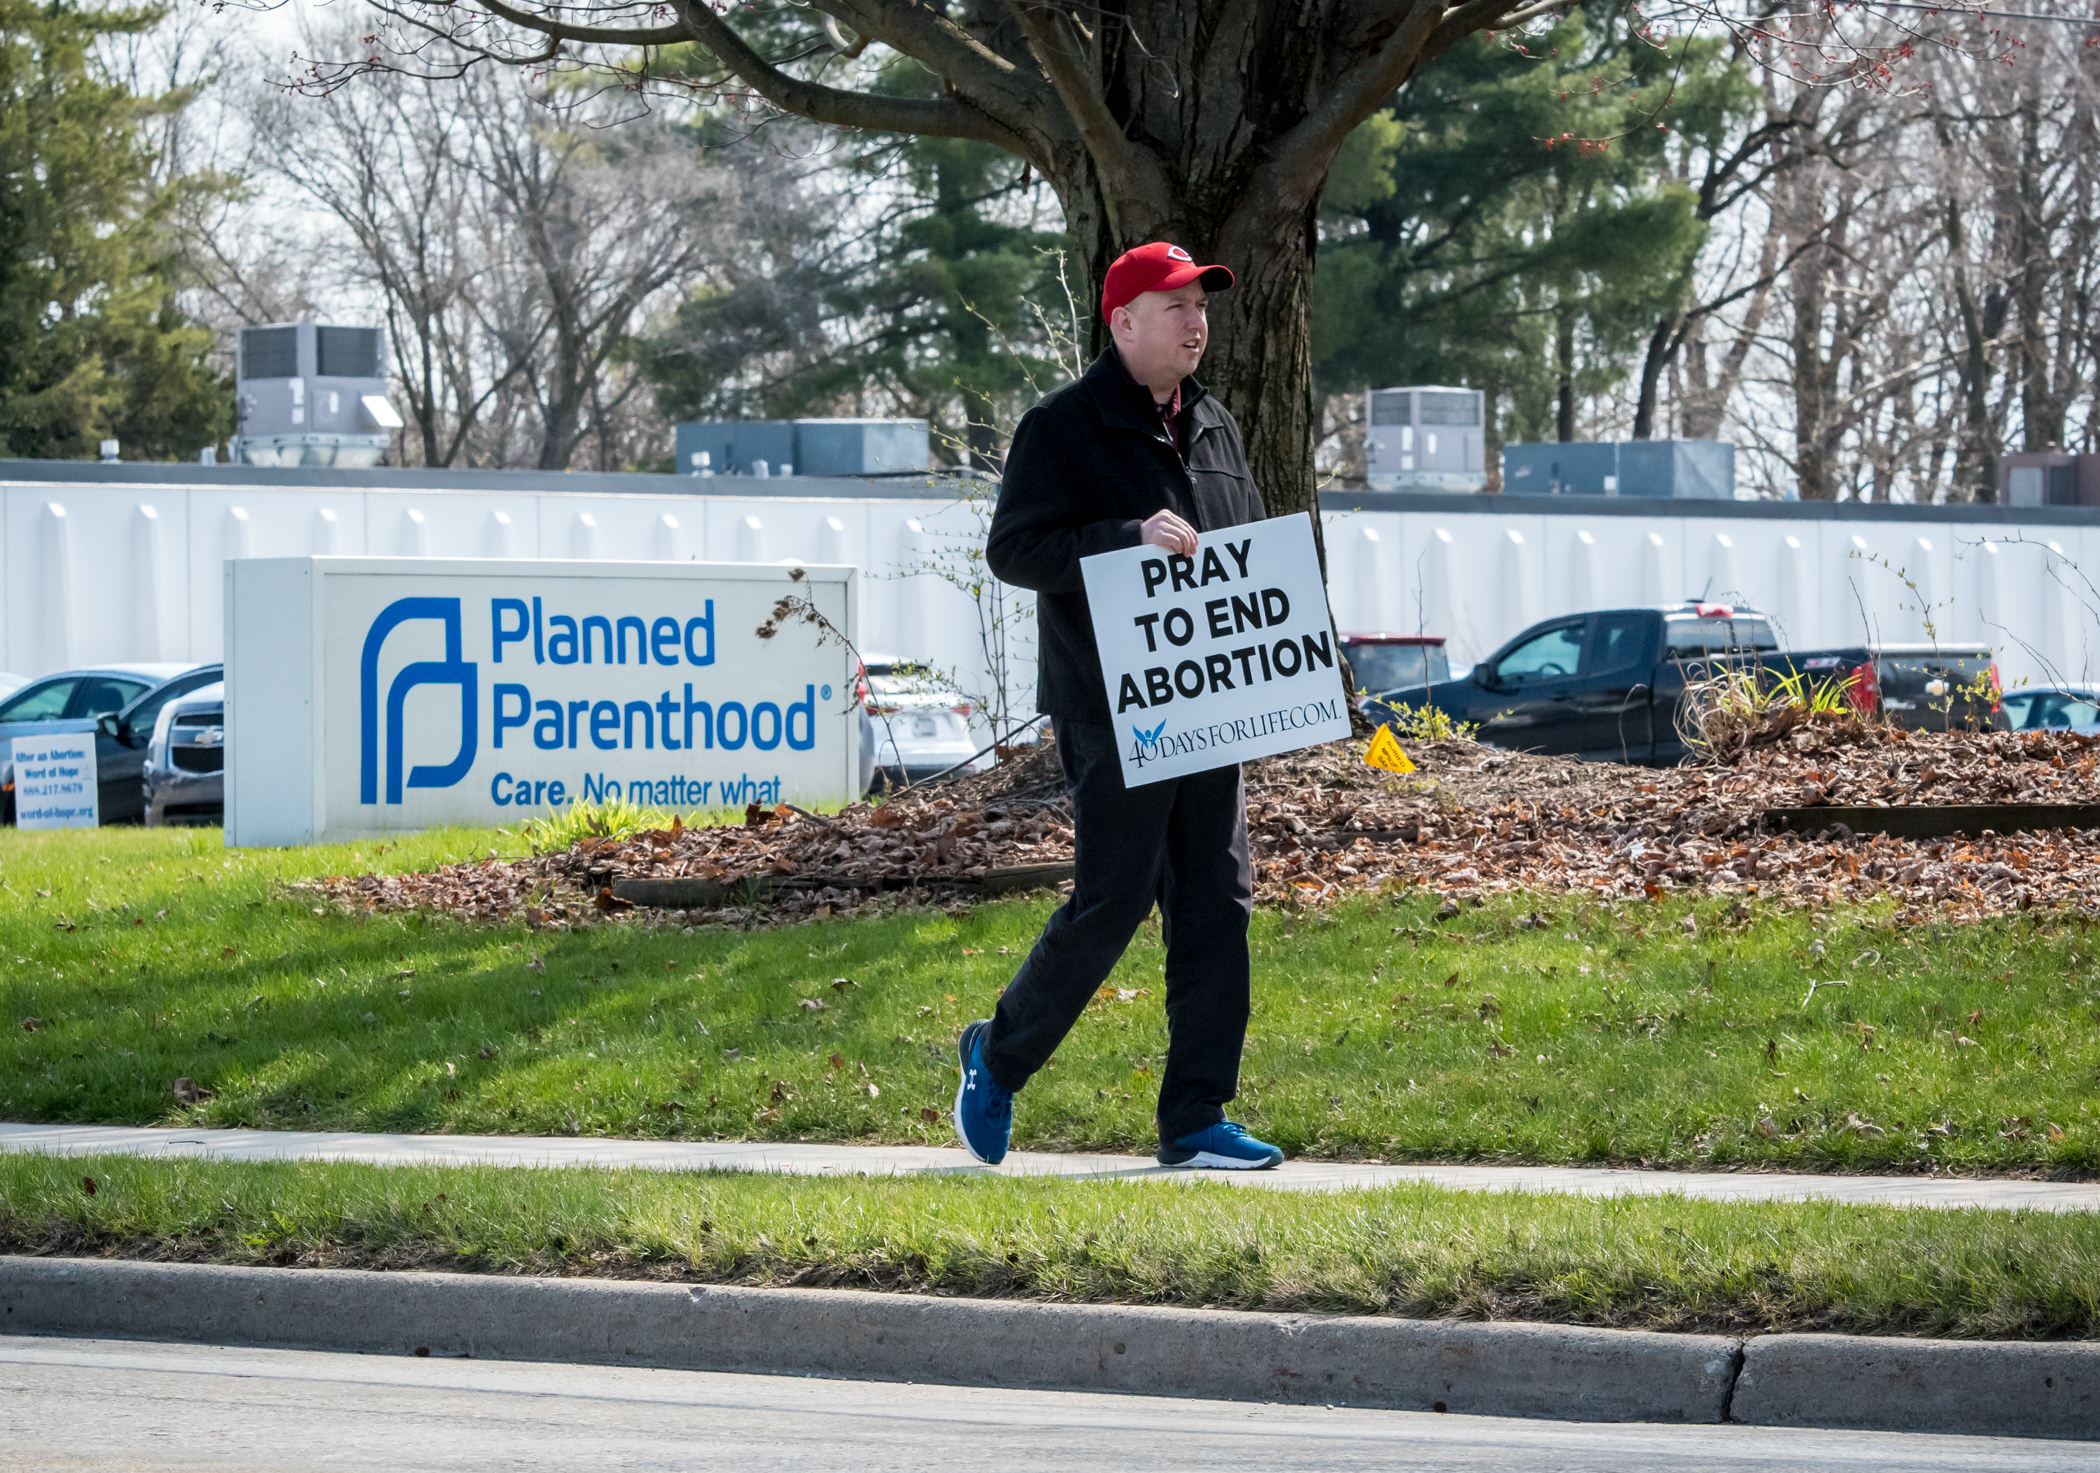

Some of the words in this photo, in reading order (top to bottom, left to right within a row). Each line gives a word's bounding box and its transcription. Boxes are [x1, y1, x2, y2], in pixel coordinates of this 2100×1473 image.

[1140, 538, 1252, 598] PRAY
[491, 596, 715, 666] Planned
[1133, 607, 1195, 653] TO
[1205, 587, 1290, 639] END
[1117, 630, 1334, 714] ABORTION
[491, 771, 574, 806] Care.
[584, 772, 621, 805] No
[628, 775, 713, 806] matter
